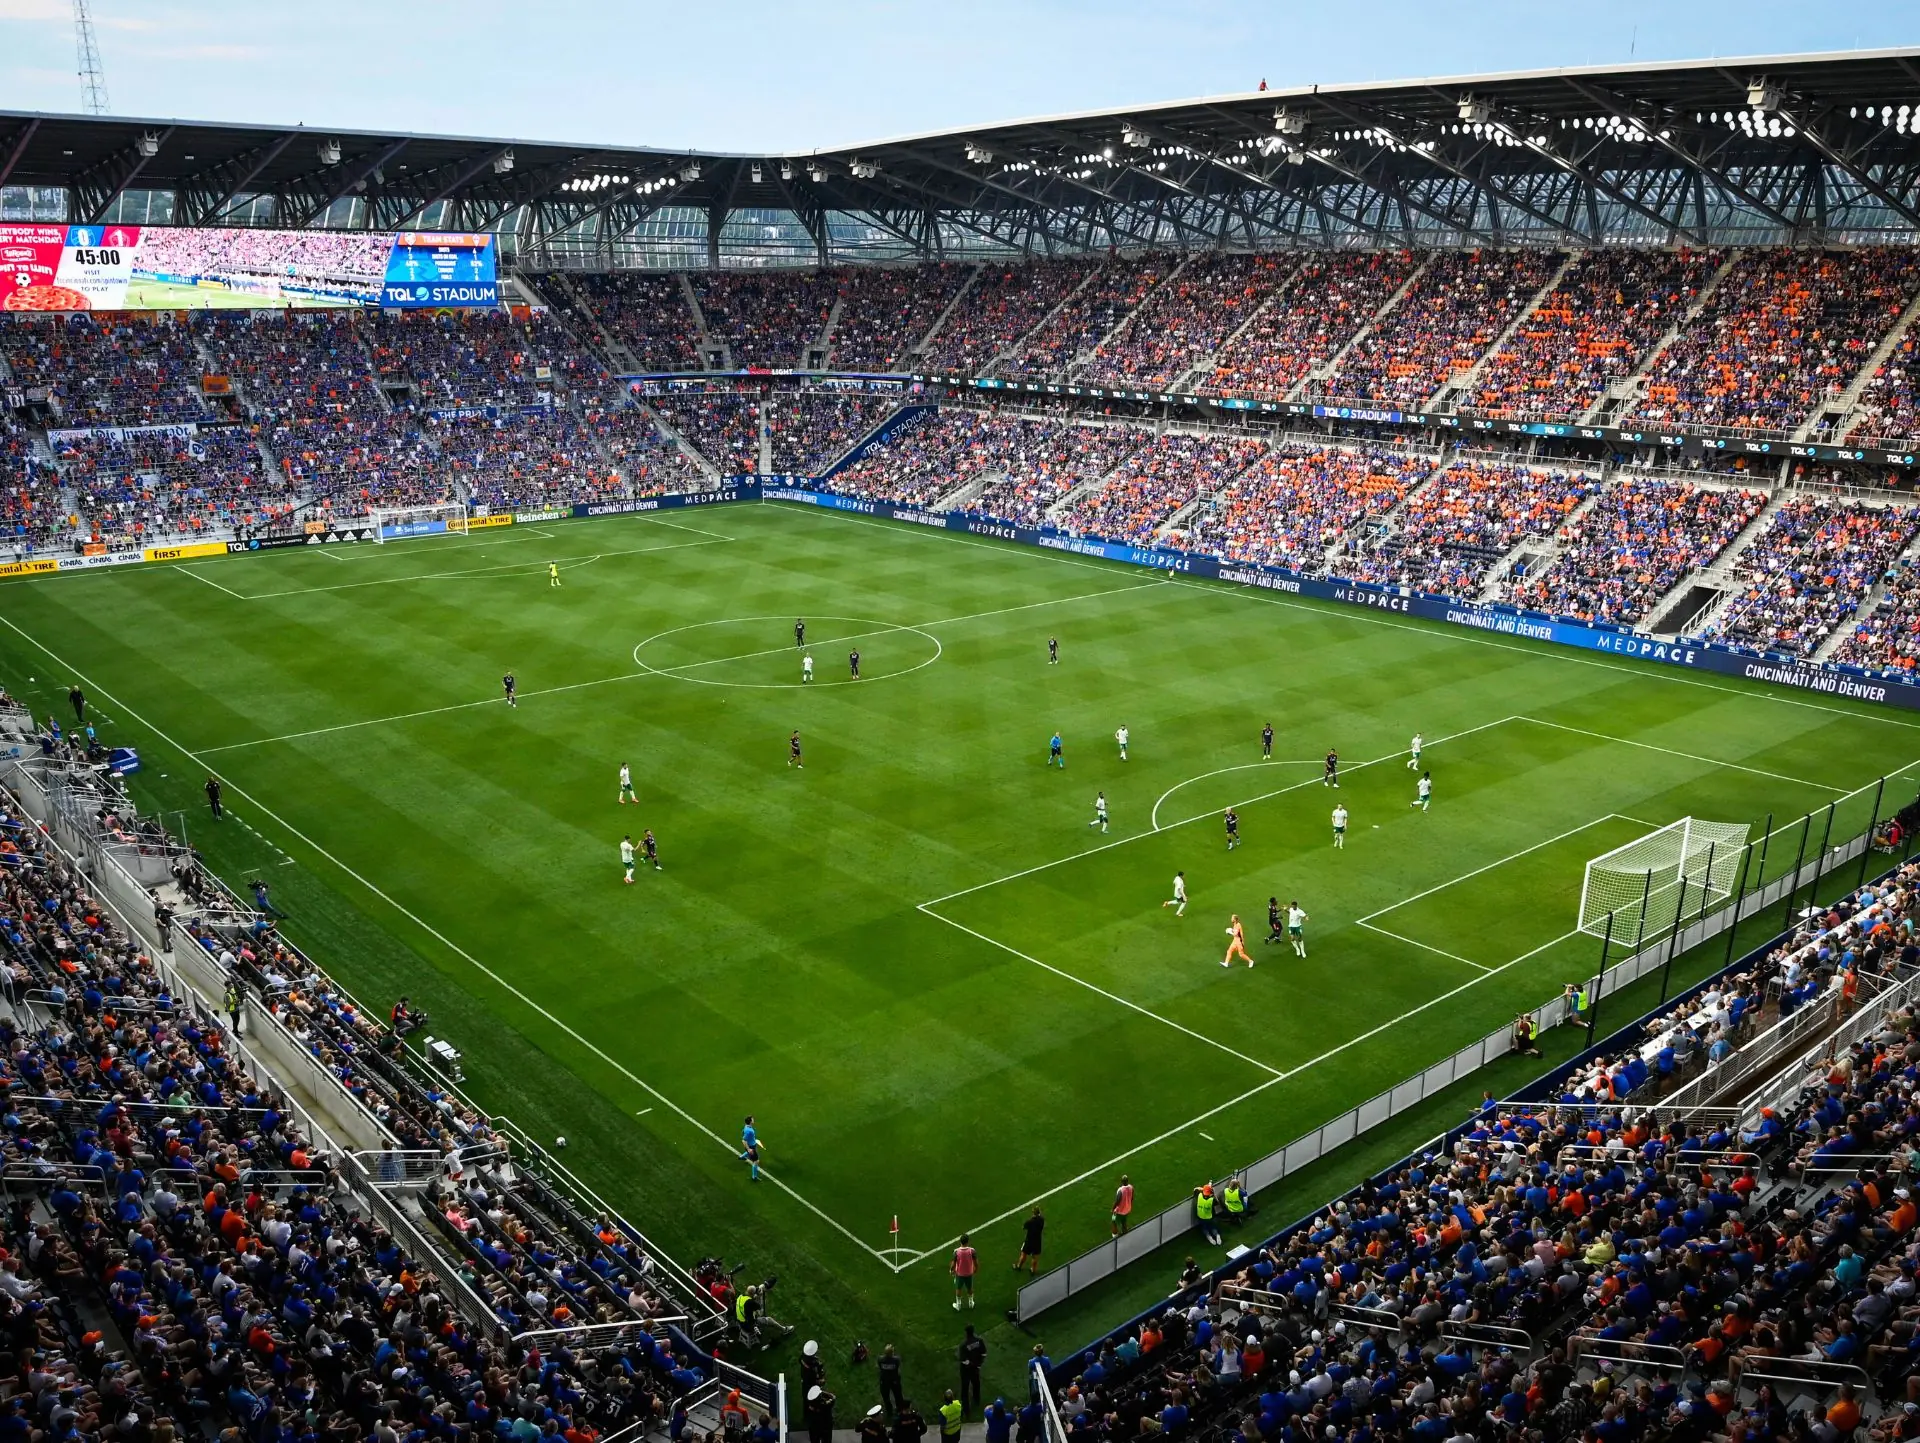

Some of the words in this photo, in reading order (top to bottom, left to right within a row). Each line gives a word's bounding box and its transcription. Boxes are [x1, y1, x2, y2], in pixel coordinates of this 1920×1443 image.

[78, 229, 89, 246] 0
[116, 229, 124, 247] 1
[75, 249, 121, 265] 45:00
[386, 288, 416, 301] TQL
[433, 288, 495, 301] STADIUM
[1262, 403, 1272, 411] TQL
[1289, 405, 1299, 413] TQL
[1324, 407, 1340, 417] TQL
[1351, 409, 1391, 420] STADIUM
[438, 411, 456, 419] THE
[1407, 415, 1420, 423] TQL
[1440, 418, 1453, 426] TQL
[1508, 423, 1522, 431] TQL
[865, 440, 883, 455] TQL
[890, 408, 928, 438] STADIUM
[1544, 426, 1558, 434] TQL
[1620, 433, 1635, 441] TQL
[1661, 436, 1676, 444] TQL
[1702, 439, 1717, 448] TQL
[1746, 443, 1762, 451] TQL
[1791, 446, 1807, 455] TQL
[1838, 451, 1854, 460] TQL
[1886, 455, 1904, 464] TQL
[685, 491, 737, 504] MEDPACE
[588, 504, 622, 516] CINCINNATI
[623, 503, 635, 512] AND
[636, 501, 659, 511] DENVER
[836, 499, 875, 513] MEDPACE
[516, 511, 560, 523] Heineken
[893, 510, 918, 523] CINCINNATI
[918, 514, 928, 524] AND
[928, 516, 947, 528] DENVER
[968, 522, 1016, 539] MEDPACE
[228, 542, 250, 552] TQL
[1039, 536, 1070, 551] CINCINNATI
[1069, 541, 1082, 553] AND
[1082, 544, 1105, 557] DENVER
[33, 562, 55, 570] TIRE
[1219, 569, 1257, 585] CINCINNATI
[1256, 575, 1272, 588] AND
[1272, 578, 1300, 593] DENVER
[1334, 588, 1409, 611] MEDPACE
[1446, 610, 1495, 630] CINCINNATI
[1495, 619, 1516, 633] AND
[1516, 622, 1552, 640] DENVER
[1597, 635, 1695, 664] MEDPACE
[1781, 664, 1806, 675] WE'RE
[1810, 669, 1838, 680] HIRING
[1745, 664, 1809, 688] CINCINNATI
[1810, 676, 1837, 693] AND
[1837, 681, 1886, 701] DENVER
[585, 1401, 595, 1414] 9
[606, 1401, 621, 1418] 31
